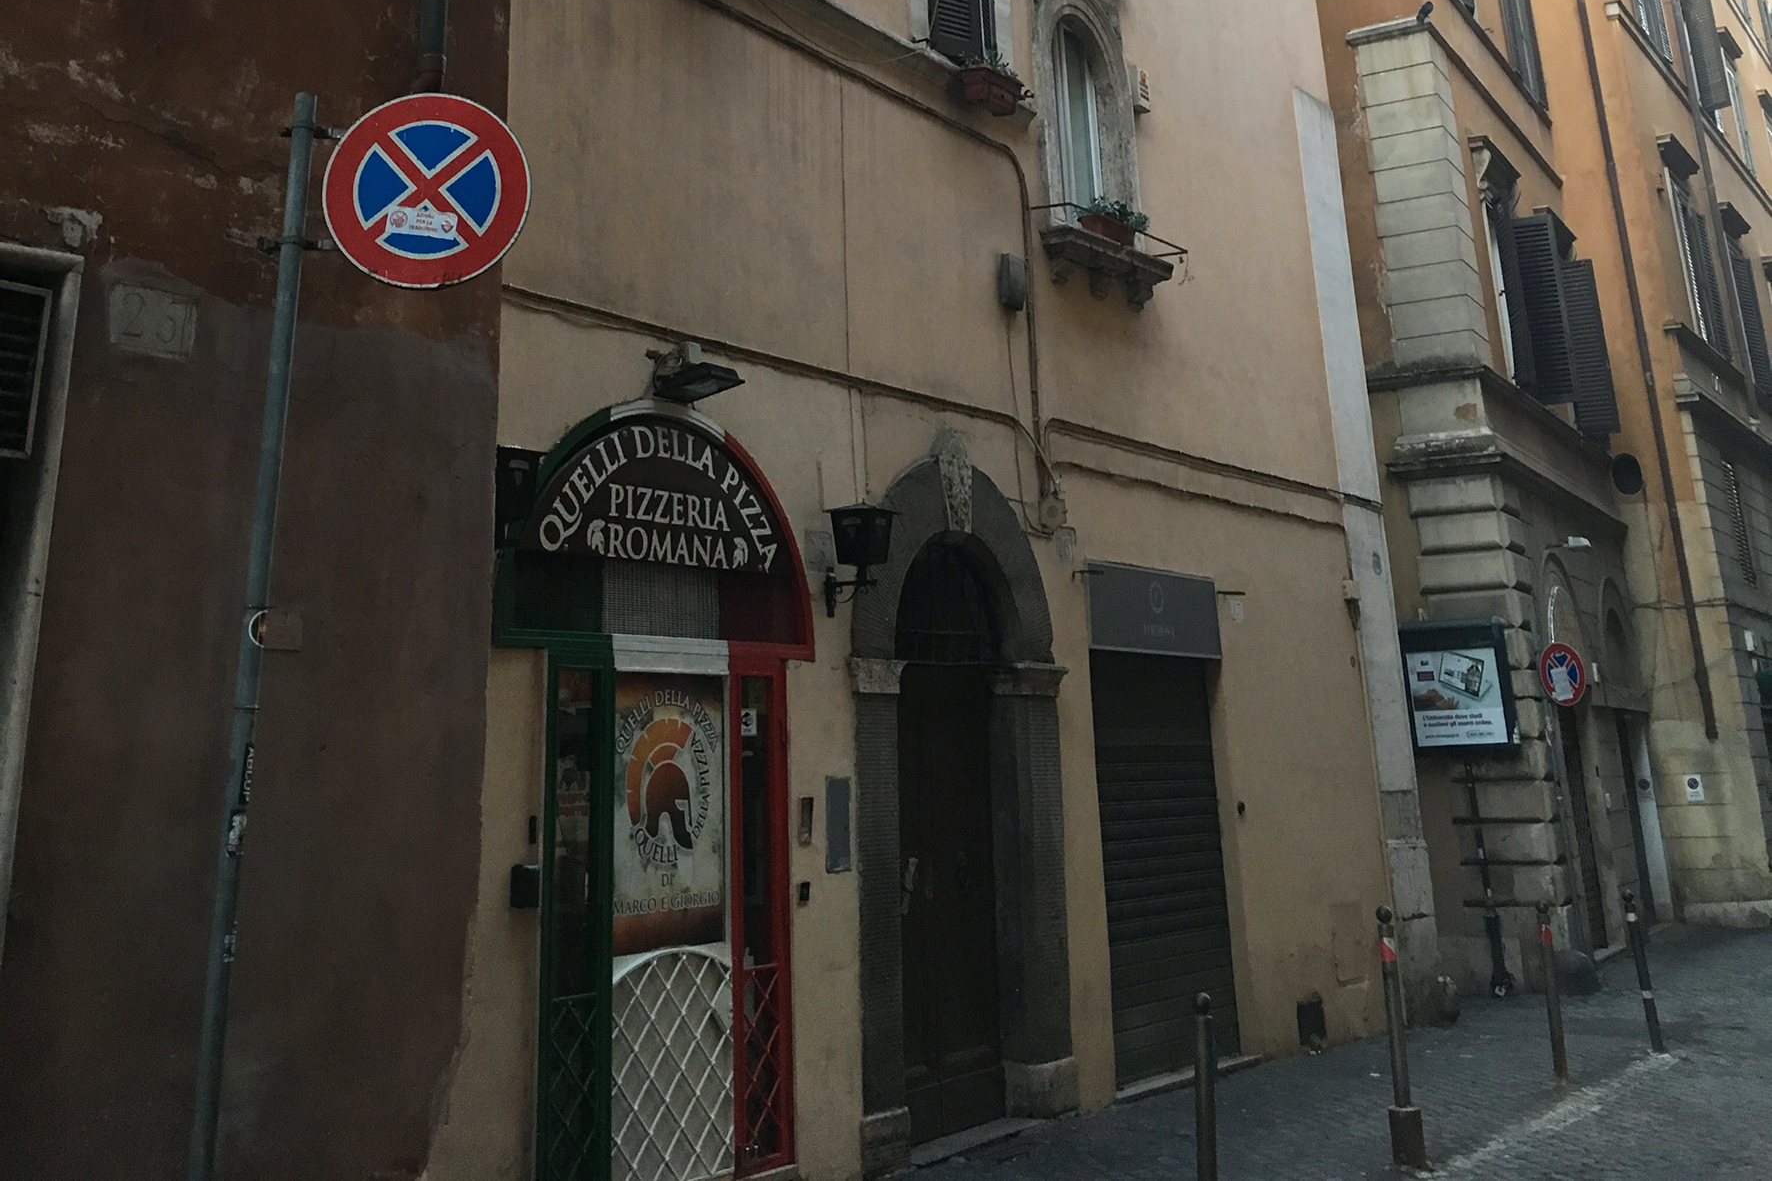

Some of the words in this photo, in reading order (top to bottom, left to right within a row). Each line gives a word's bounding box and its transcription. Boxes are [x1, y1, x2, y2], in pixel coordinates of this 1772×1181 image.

[539, 429, 628, 552] QUELLI
[630, 425, 717, 480] DELLA
[719, 462, 779, 573] PIZZA
[608, 482, 732, 532] PIZZERIA
[606, 522, 730, 570] ROMANA
[615, 695, 652, 754] QUELLI
[654, 689, 690, 710] DELLA
[692, 701, 718, 753] PIZZA
[690, 731, 710, 789] PIZZA
[691, 793, 710, 840] DELLA
[634, 827, 679, 863] QUELLI
[661, 872, 674, 887] DI
[613, 897, 657, 915] MARCO
[661, 896, 668, 910] E
